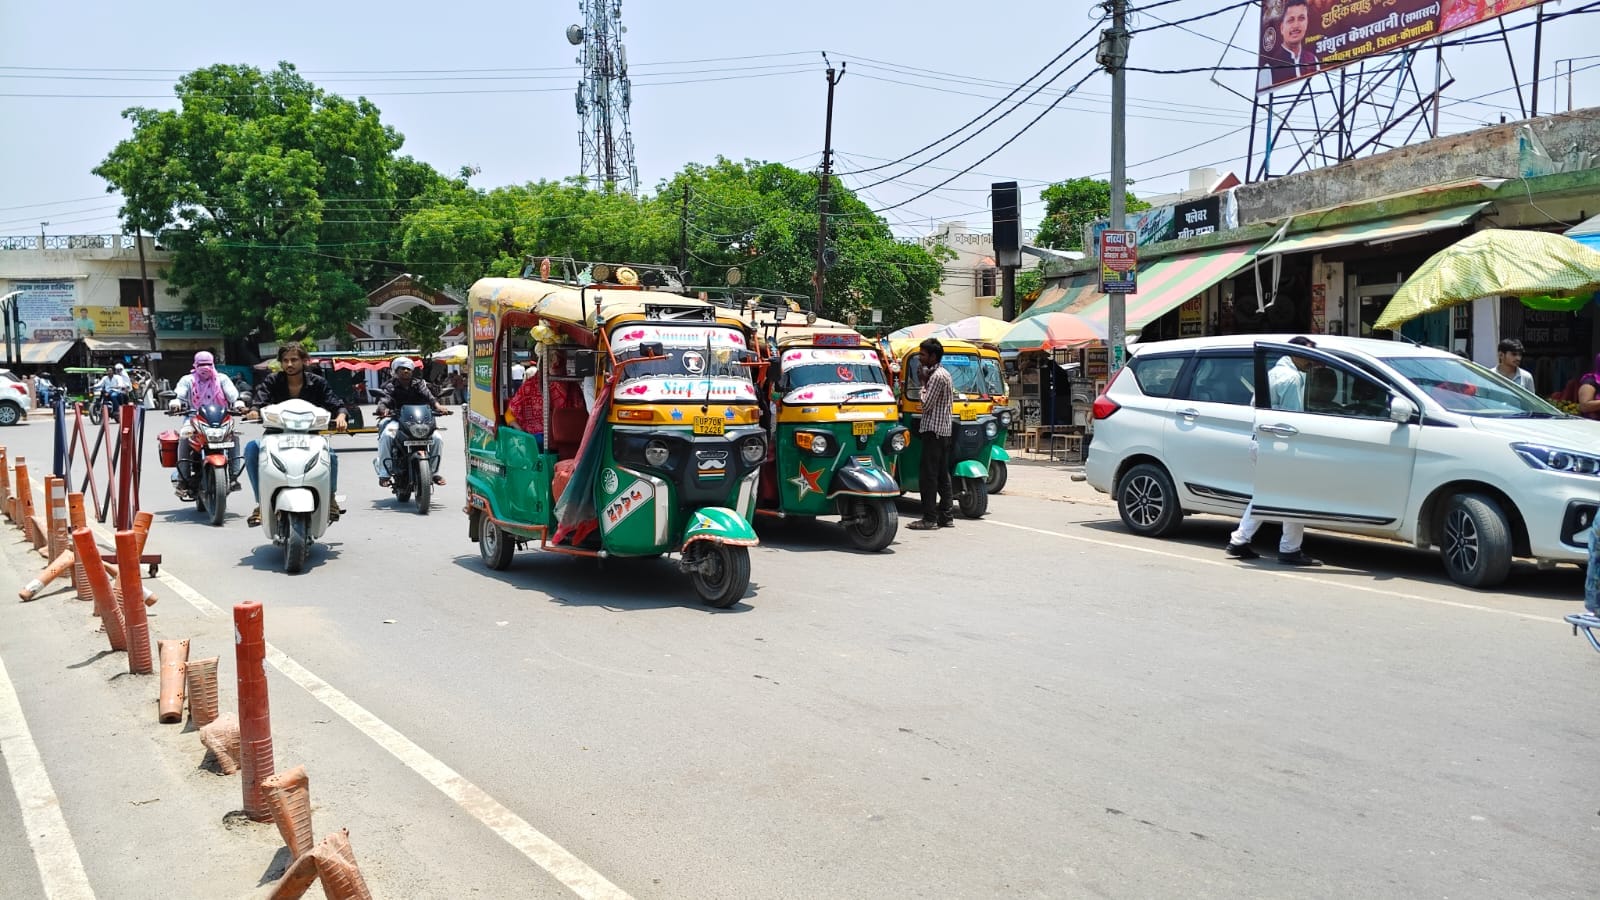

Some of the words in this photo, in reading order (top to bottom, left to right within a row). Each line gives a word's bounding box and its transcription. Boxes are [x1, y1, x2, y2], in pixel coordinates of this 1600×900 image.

[1315, 33, 1348, 54] अंशुल
[1348, 12, 1400, 42] केशरवानी
[1400, 1, 1440, 27] (सभासद)
[660, 381, 694, 398] Sirf
